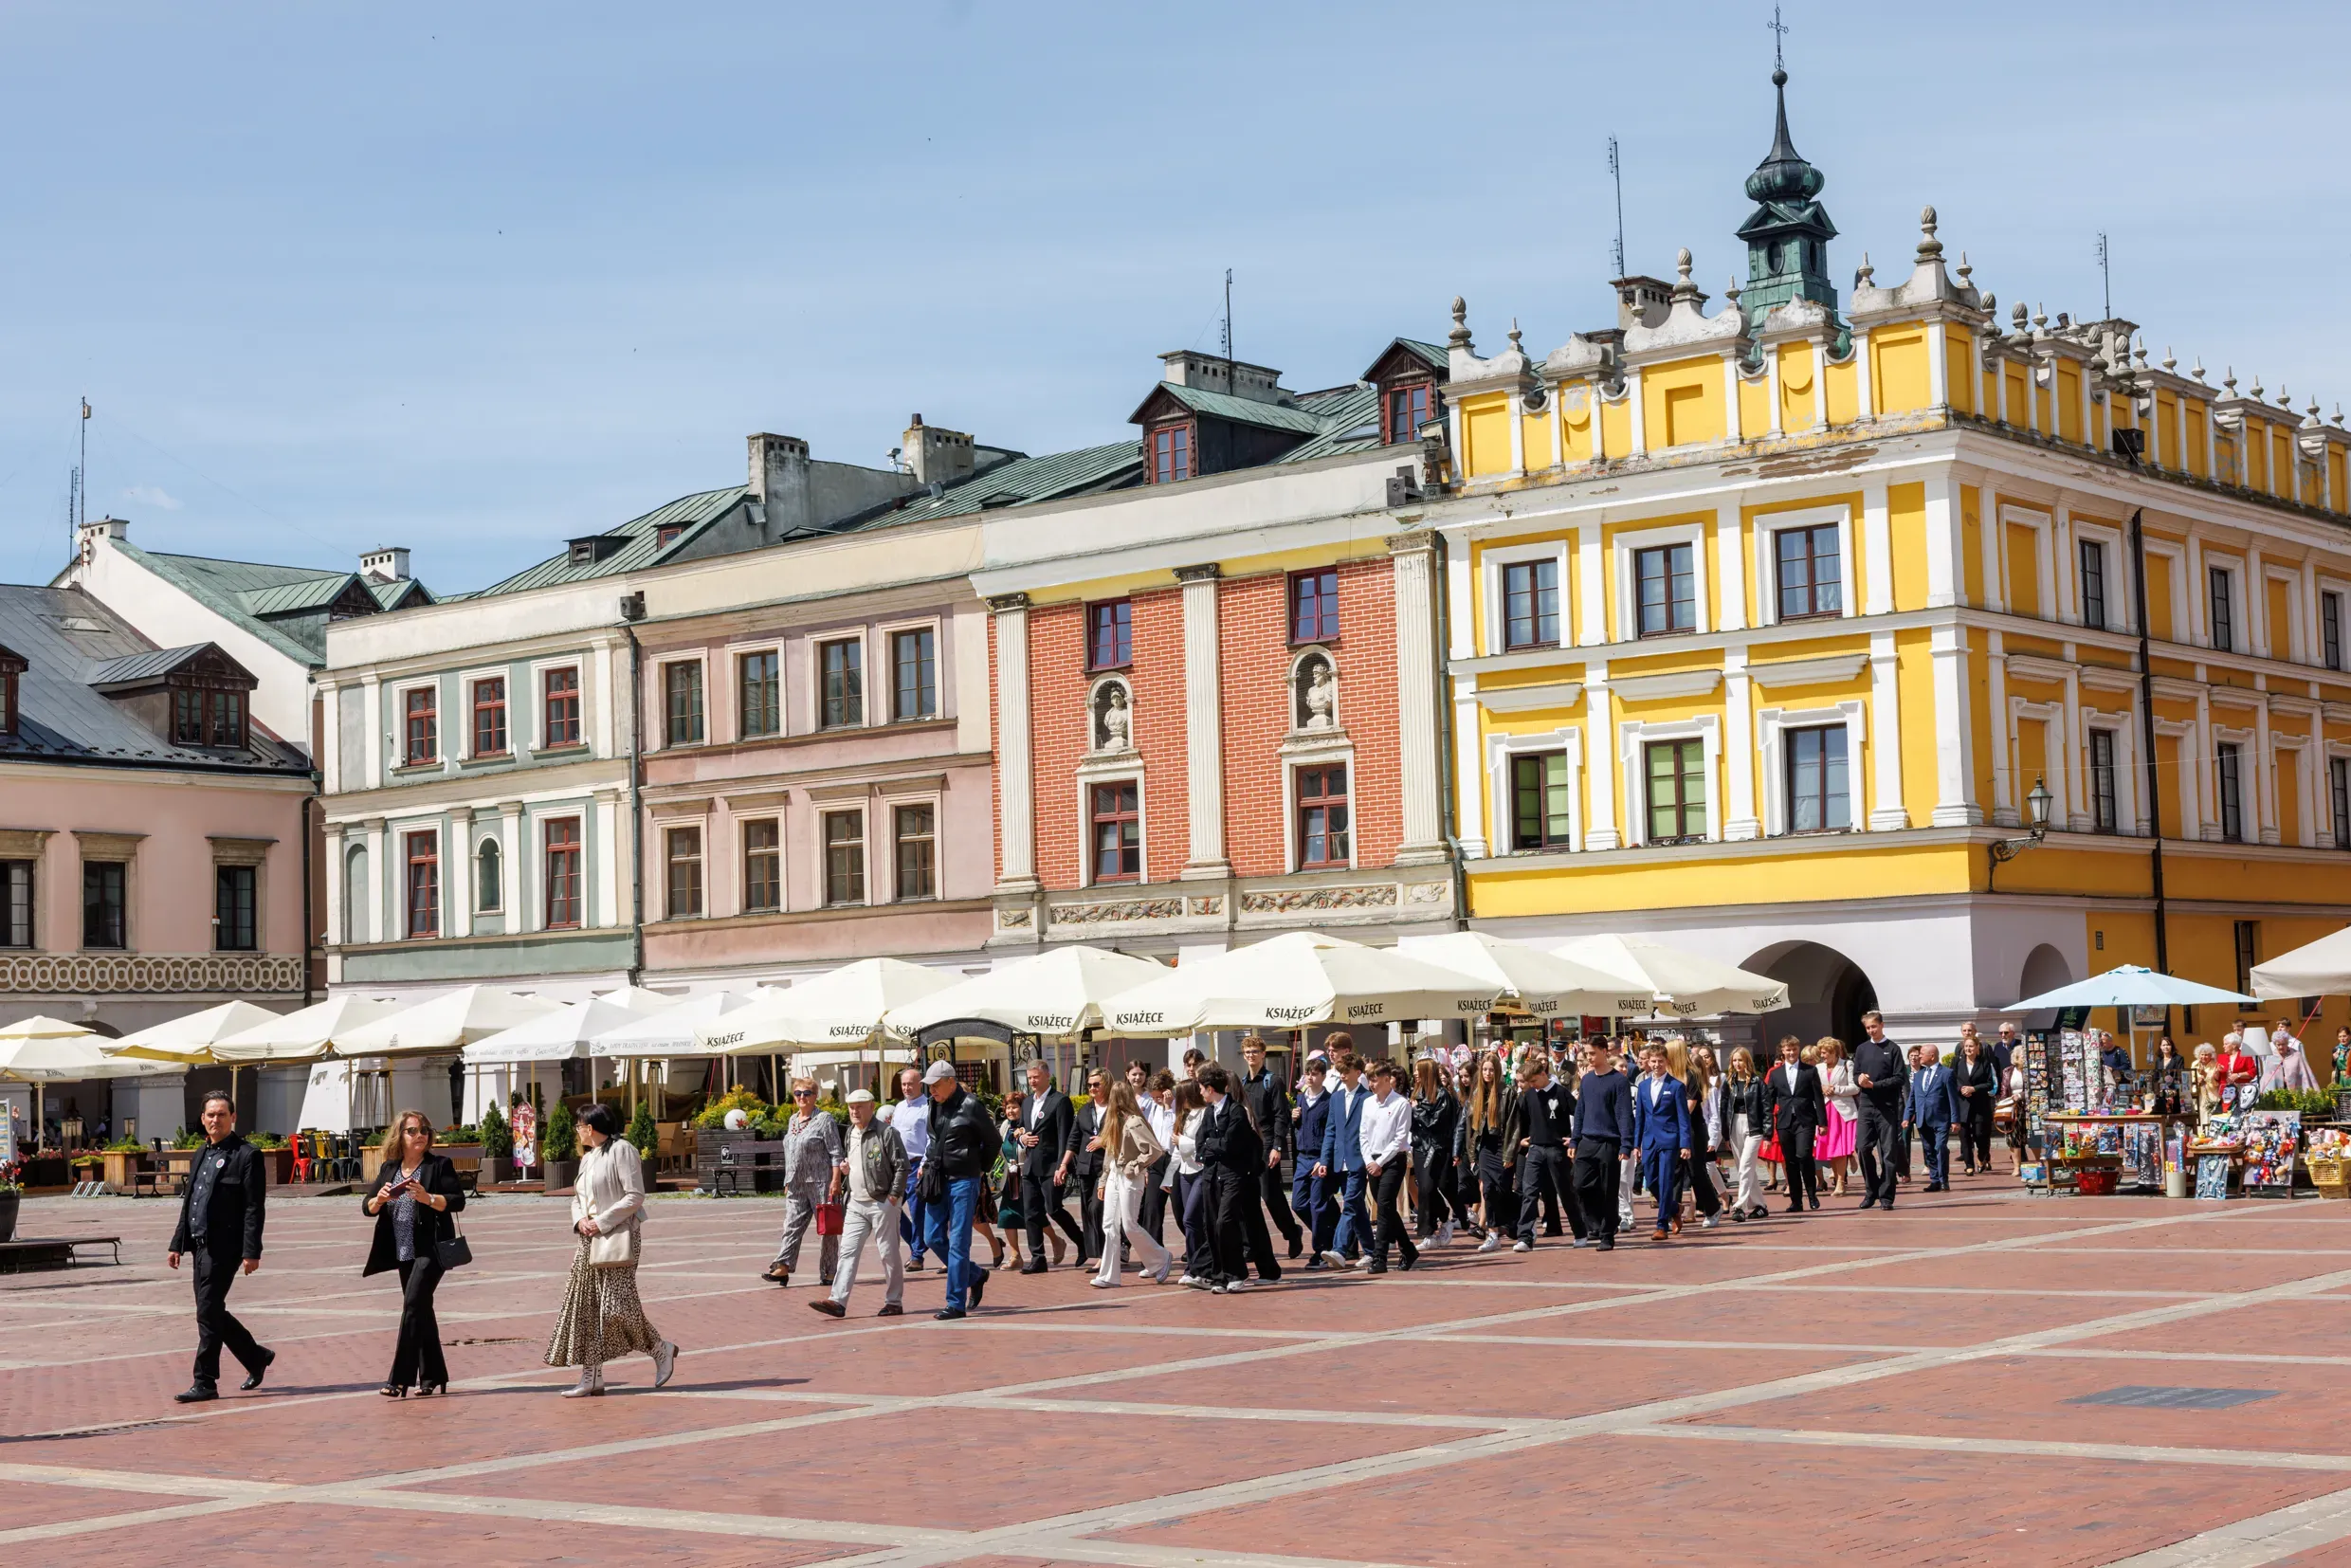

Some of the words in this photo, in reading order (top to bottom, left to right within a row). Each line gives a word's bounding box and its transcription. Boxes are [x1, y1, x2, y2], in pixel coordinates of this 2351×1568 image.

[1347, 1002, 1383, 1018] KSIĄŻĘCE
[1618, 997, 1647, 1012] KSIĄŻĘCE
[1028, 1013, 1072, 1029] KSIĄŻĘCE
[1116, 1011, 1164, 1025] KSIĄŻĘCE
[1266, 1006, 1316, 1021] KSIĄŻĘCE
[706, 1031, 745, 1048] KSIĄŻĘCE
